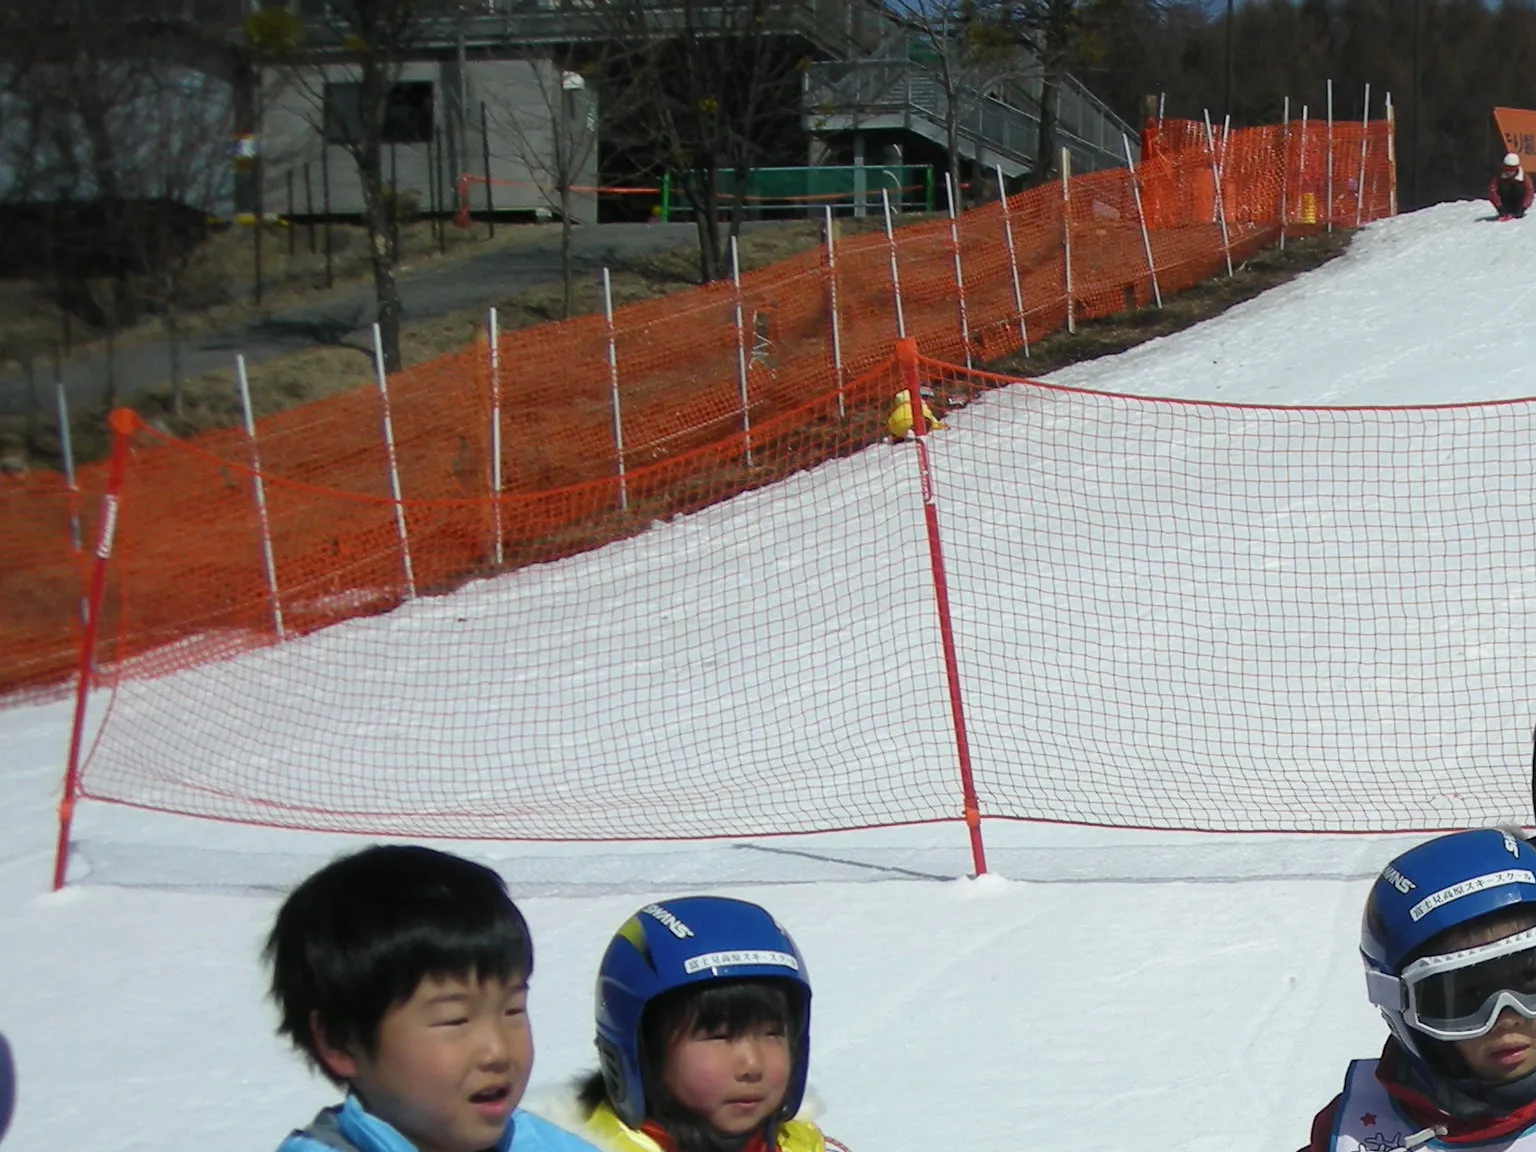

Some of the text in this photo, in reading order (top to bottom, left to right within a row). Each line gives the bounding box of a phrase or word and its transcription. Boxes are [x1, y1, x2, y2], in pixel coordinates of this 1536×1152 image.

[1412, 871, 1533, 919] 富士見高原スキースクール
[642, 904, 694, 939] SWANS
